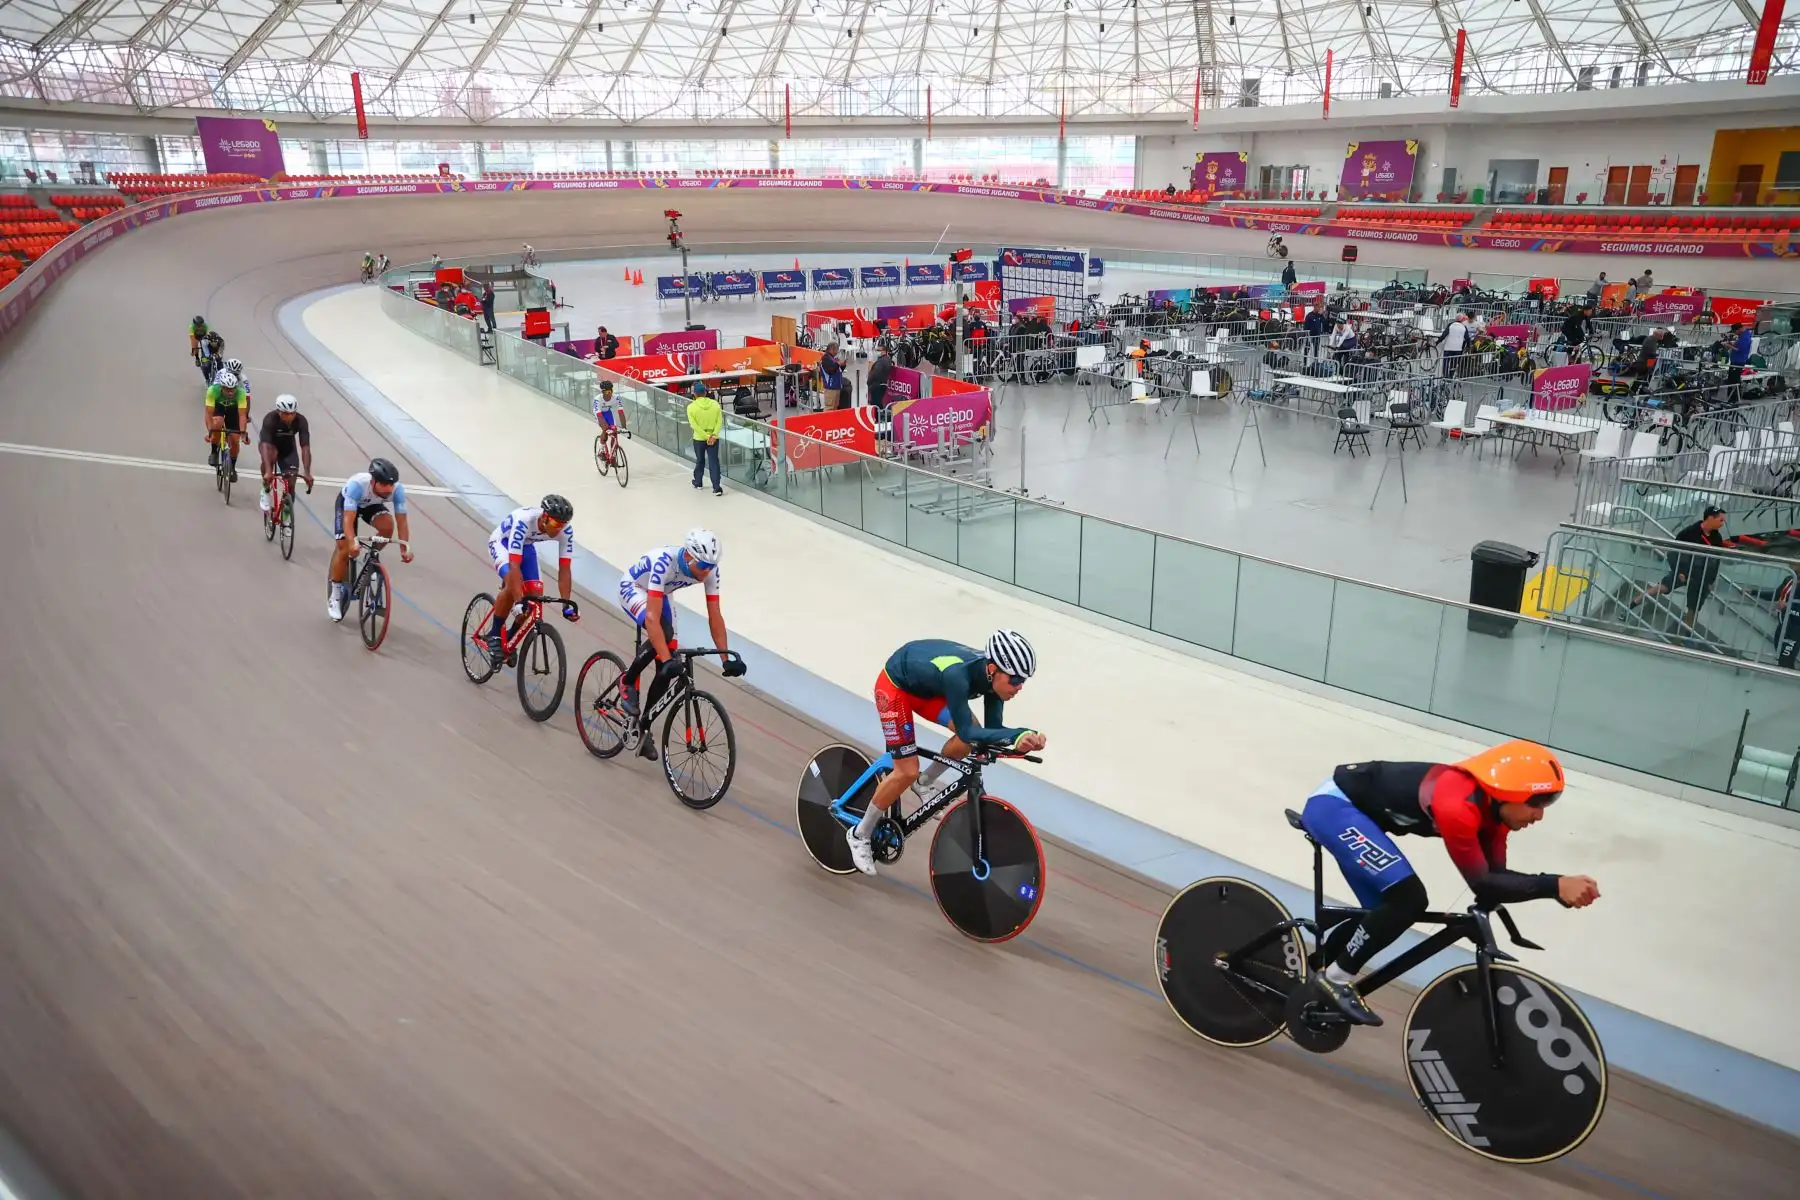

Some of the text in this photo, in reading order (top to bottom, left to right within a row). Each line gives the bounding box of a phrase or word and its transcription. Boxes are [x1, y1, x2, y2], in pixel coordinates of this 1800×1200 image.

[1347, 229, 1418, 242] SEGUIMOS JUGANDO
[1600, 242, 1704, 254] SEGUIMOS JUGANDO
[642, 368, 668, 378] FDPC
[825, 427, 855, 440] FDPC
[510, 520, 528, 550] DOM
[650, 552, 672, 584] DOM
[648, 676, 680, 720] FELT
[933, 755, 972, 775] PINARELLO
[906, 781, 958, 826] PINARELLO
